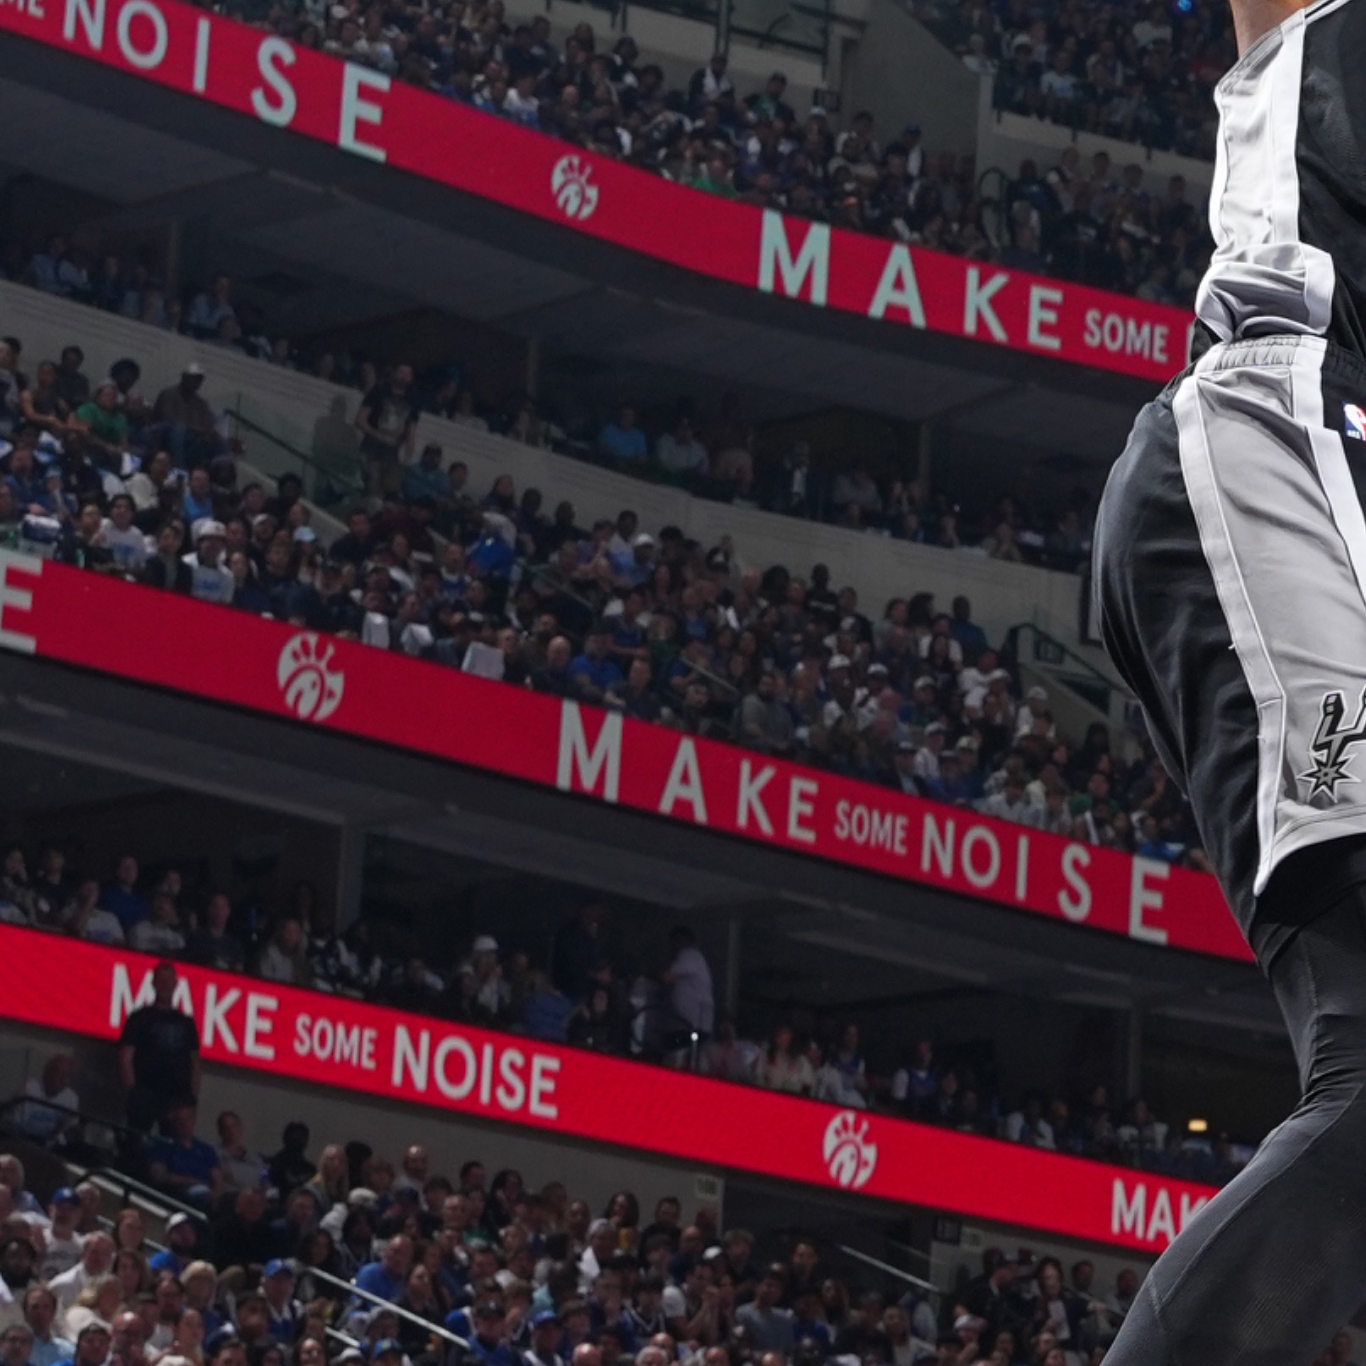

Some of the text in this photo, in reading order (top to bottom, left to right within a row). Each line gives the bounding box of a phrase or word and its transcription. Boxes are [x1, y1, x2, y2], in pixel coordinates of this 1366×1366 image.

[758, 207, 1064, 352] MAKE
[1083, 309, 1170, 364] SOME
[556, 698, 1171, 945] MAKE SOME NOISE
[293, 1012, 379, 1070] SOME
[391, 1023, 562, 1120] NOISE
